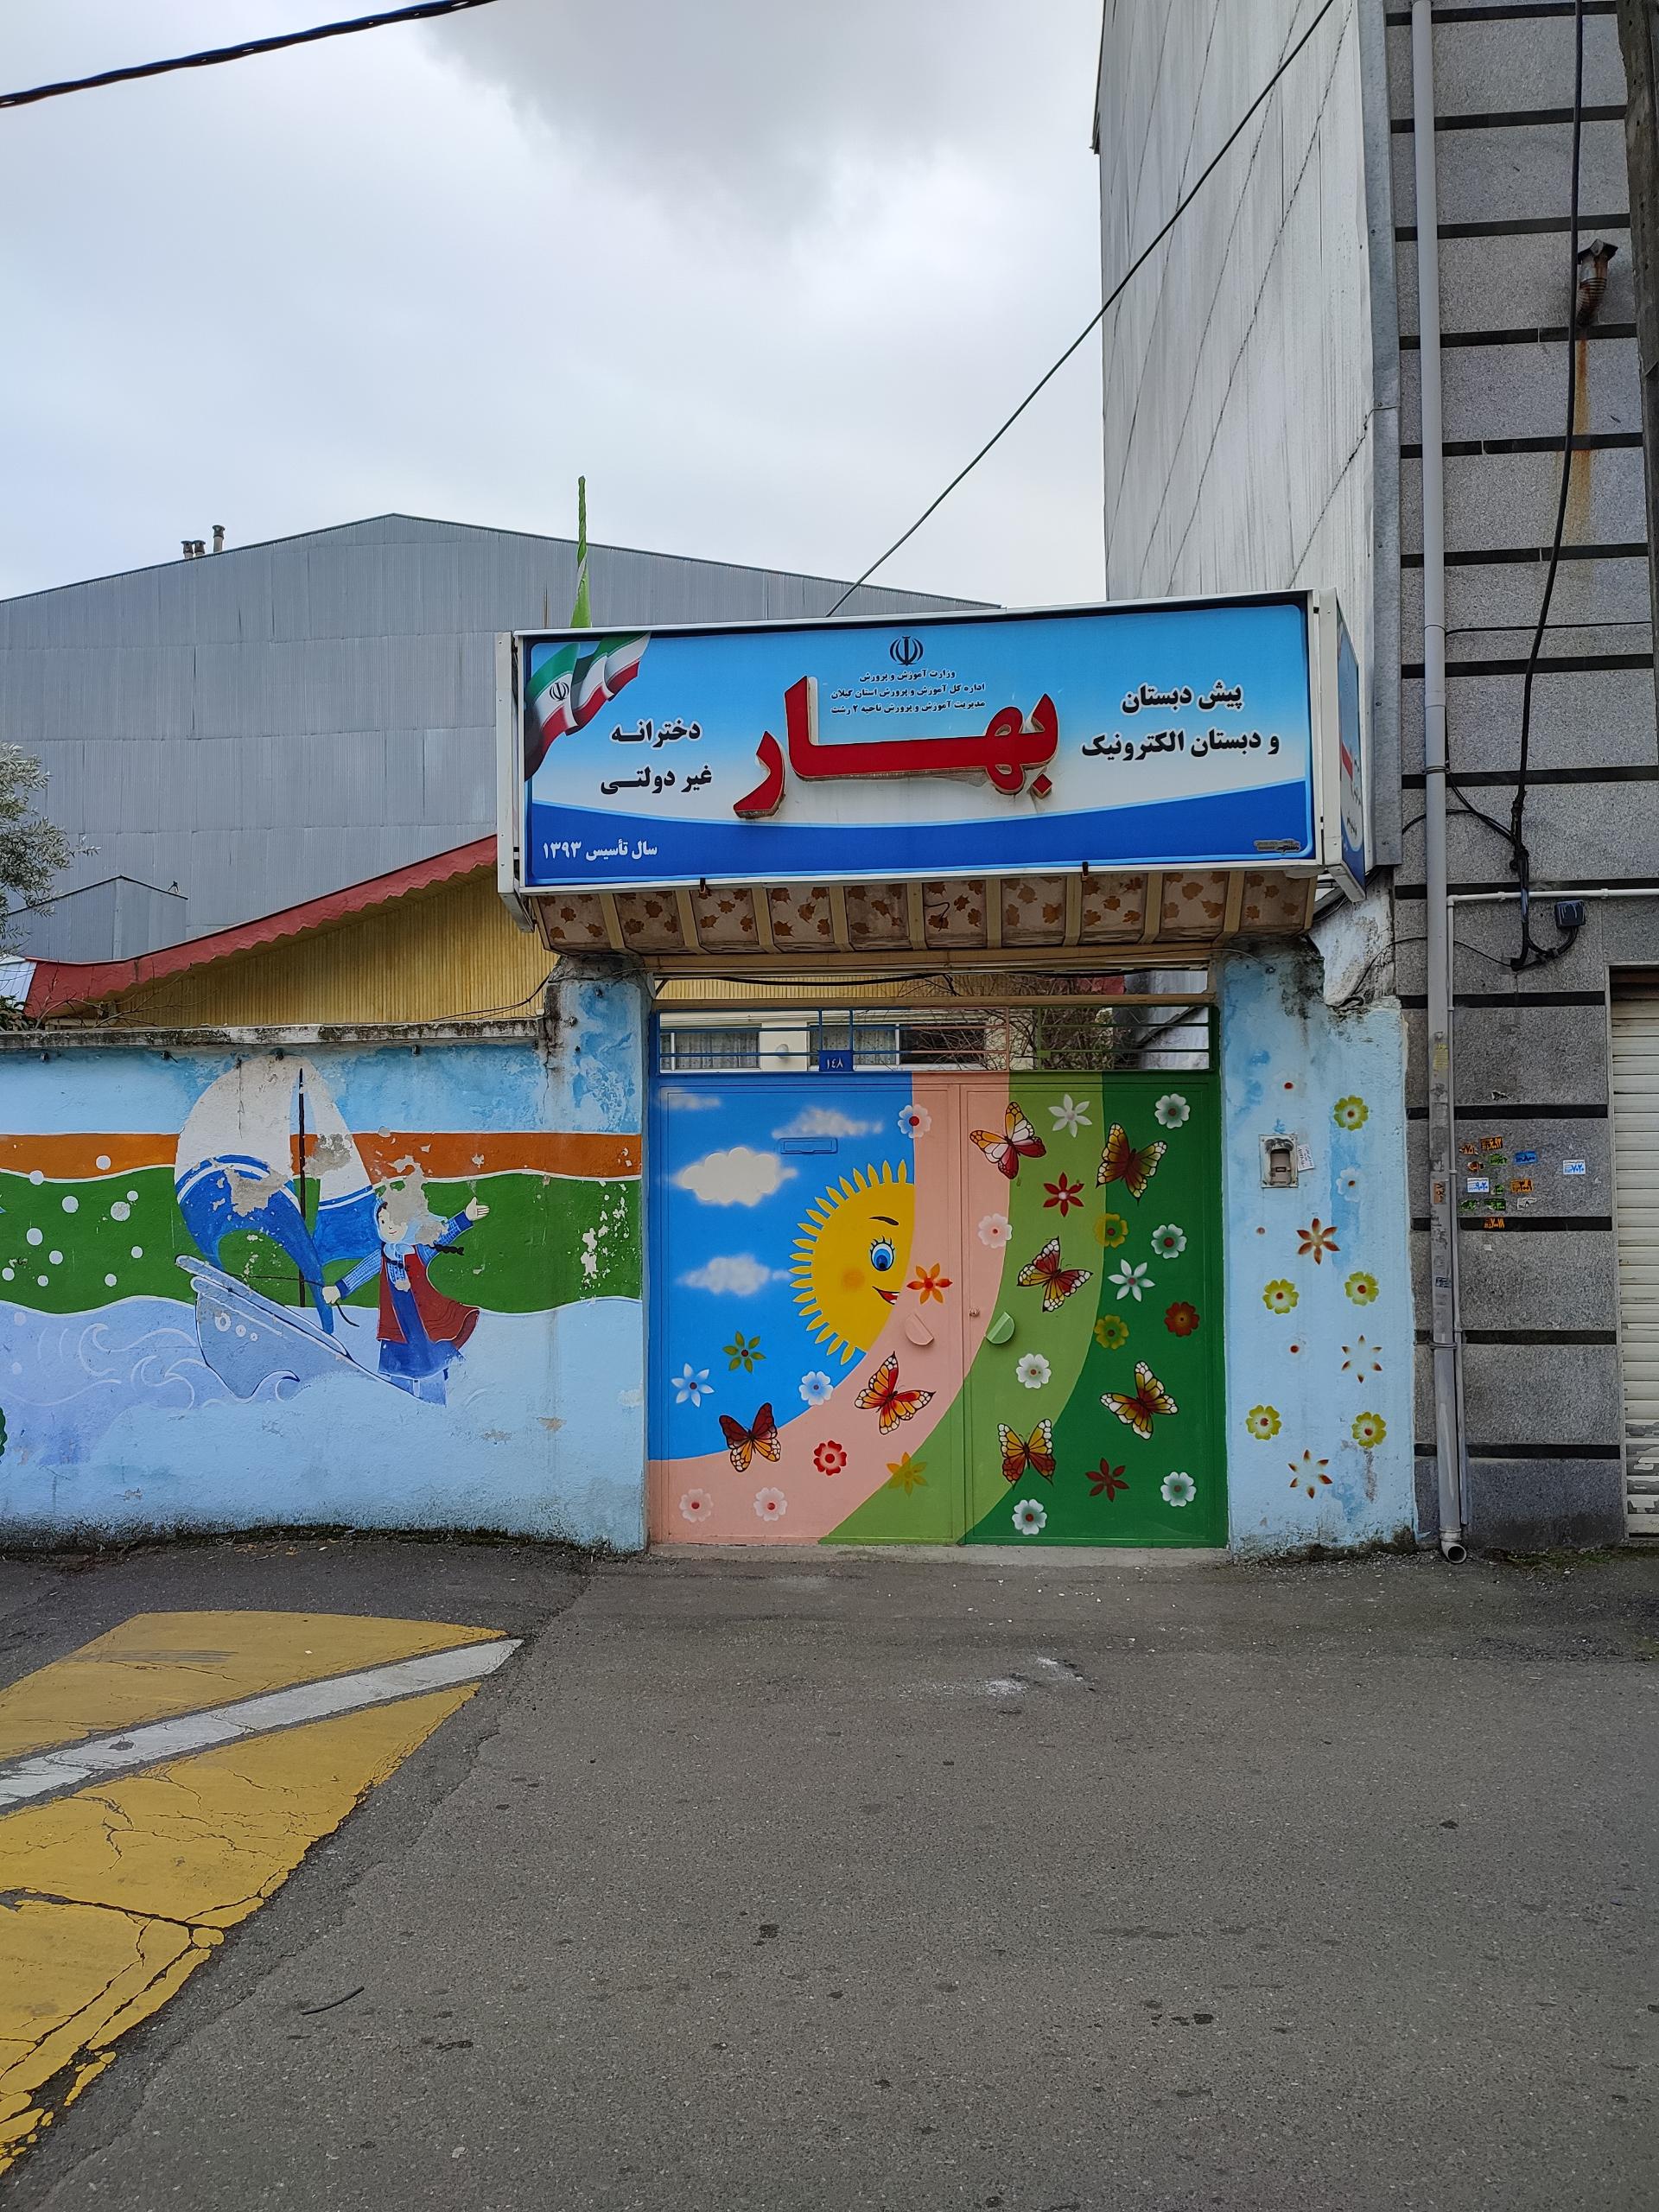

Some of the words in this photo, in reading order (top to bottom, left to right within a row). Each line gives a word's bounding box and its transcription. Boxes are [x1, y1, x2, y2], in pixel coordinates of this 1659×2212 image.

[859, 672, 888, 683] پرورش
[897, 669, 927, 681] آموزش
[929, 669, 956, 679] وزارت
[855, 689, 877, 699] استان
[879, 688, 908, 697] پرورش
[916, 683, 947, 696] آموزش
[950, 683, 962, 695] کل
[963, 683, 985, 694] اداره
[1122, 684, 1192, 714] دبستان
[1198, 682, 1243, 710] پیش
[831, 705, 851, 715] رشت
[852, 704, 858, 713] ۲
[861, 703, 882, 713] ناحیه
[883, 704, 912, 714] پرورش
[921, 700, 951, 712] آموزش
[954, 701, 986, 710] مدیریت
[611, 719, 701, 748] دخترانه
[734, 676, 1058, 819] بهار
[1082, 730, 1185, 761] الکترونیک
[1191, 728, 1262, 758] دبستان
[1268, 735, 1280, 755] و
[601, 766, 676, 795] دولتی
[681, 765, 712, 793] غیر
[543, 842, 582, 859] ۱۳۹۳
[586, 840, 628, 861] تأسیس
[632, 841, 658, 860] سال
